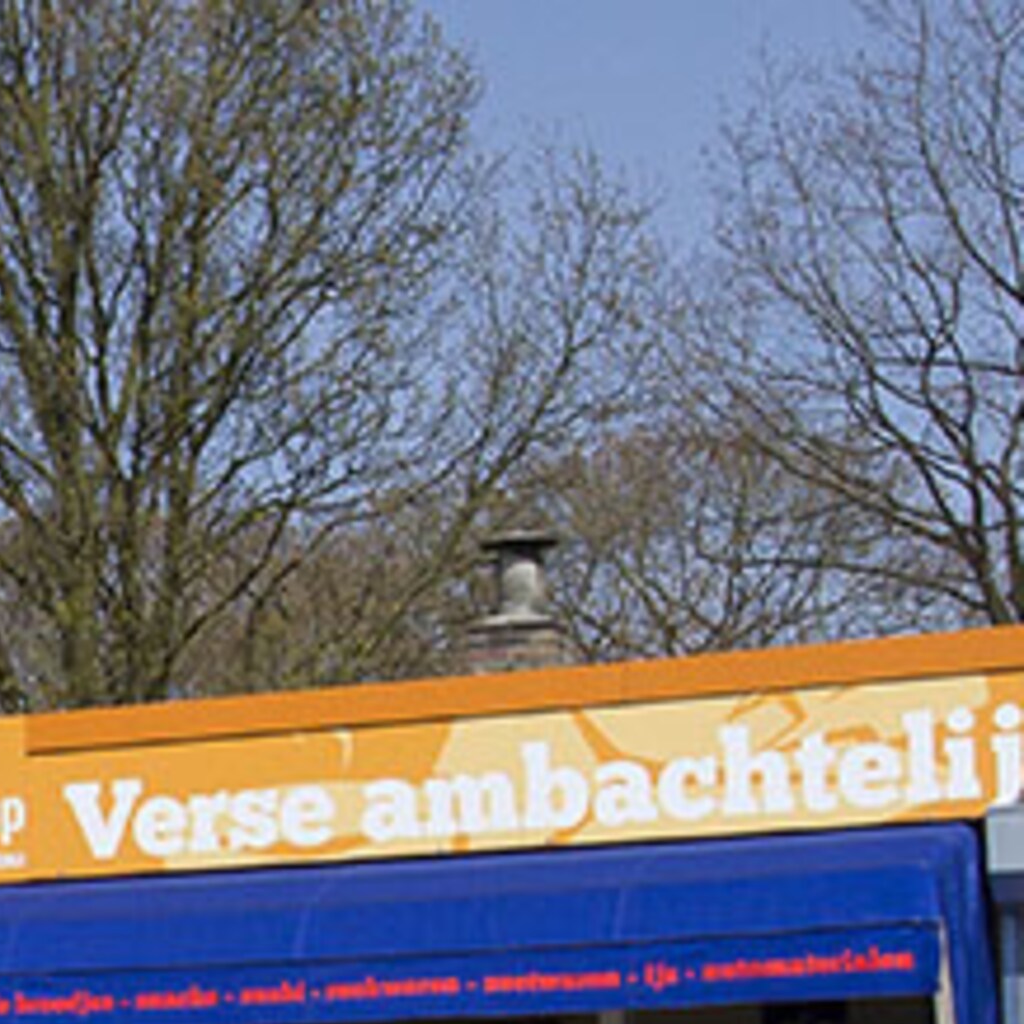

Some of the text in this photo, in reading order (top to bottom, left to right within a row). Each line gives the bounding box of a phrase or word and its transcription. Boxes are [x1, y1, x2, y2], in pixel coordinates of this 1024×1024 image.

[63, 703, 1022, 859] Verse ambachtelij
[14, 991, 114, 1015] broodjes
[702, 946, 914, 980] automaterialen
